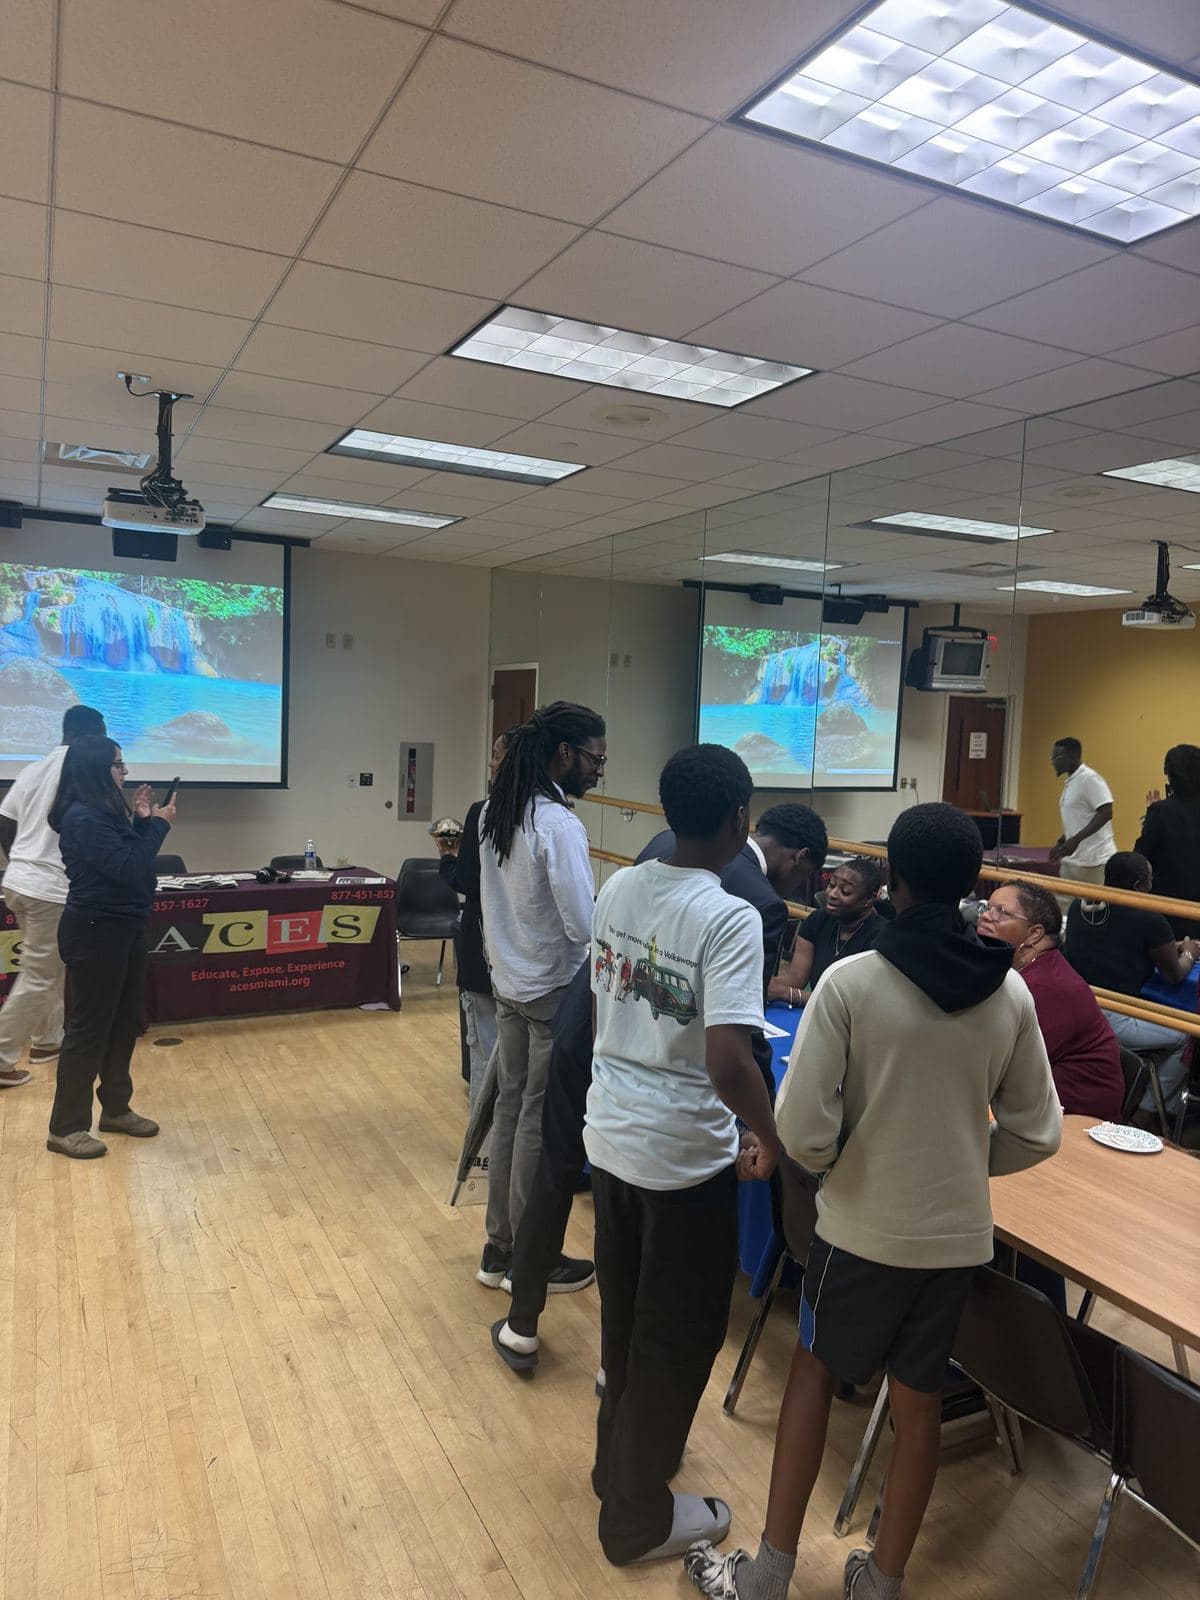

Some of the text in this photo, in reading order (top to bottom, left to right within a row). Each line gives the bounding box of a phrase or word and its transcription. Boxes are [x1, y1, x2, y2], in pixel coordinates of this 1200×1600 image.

[153, 898, 209, 912] 357-1627
[147, 914, 362, 953] ACES
[191, 960, 345, 981] Educate, Expose, Experience
[230, 977, 310, 991] acesmiami.org
